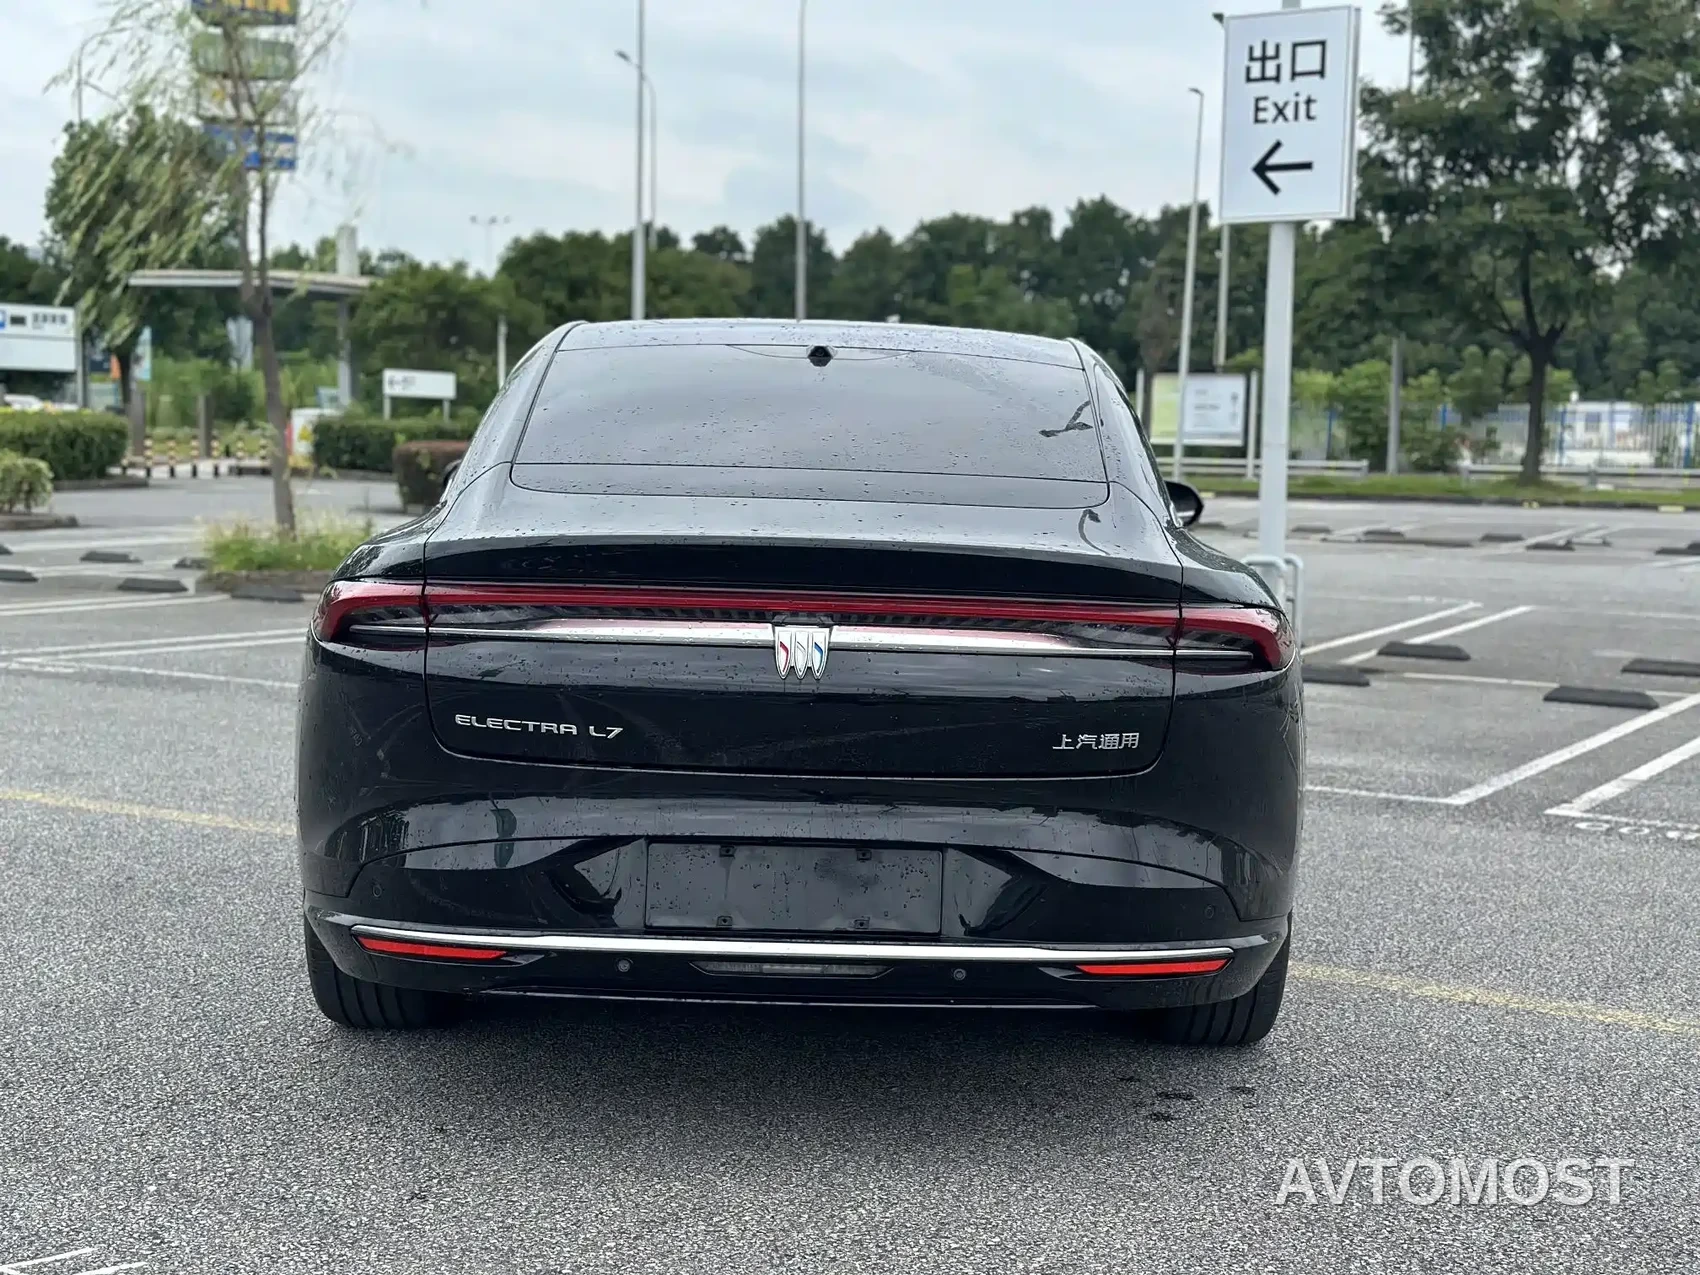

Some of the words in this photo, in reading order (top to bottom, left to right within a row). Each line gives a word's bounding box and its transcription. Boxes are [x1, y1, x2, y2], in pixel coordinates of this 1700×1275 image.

[1245, 39, 1327, 84] 出口
[1253, 92, 1317, 124] Exit
[454, 714, 578, 735] ELECTRA
[588, 725, 624, 739] L7
[1052, 732, 1140, 750] 上汽通用
